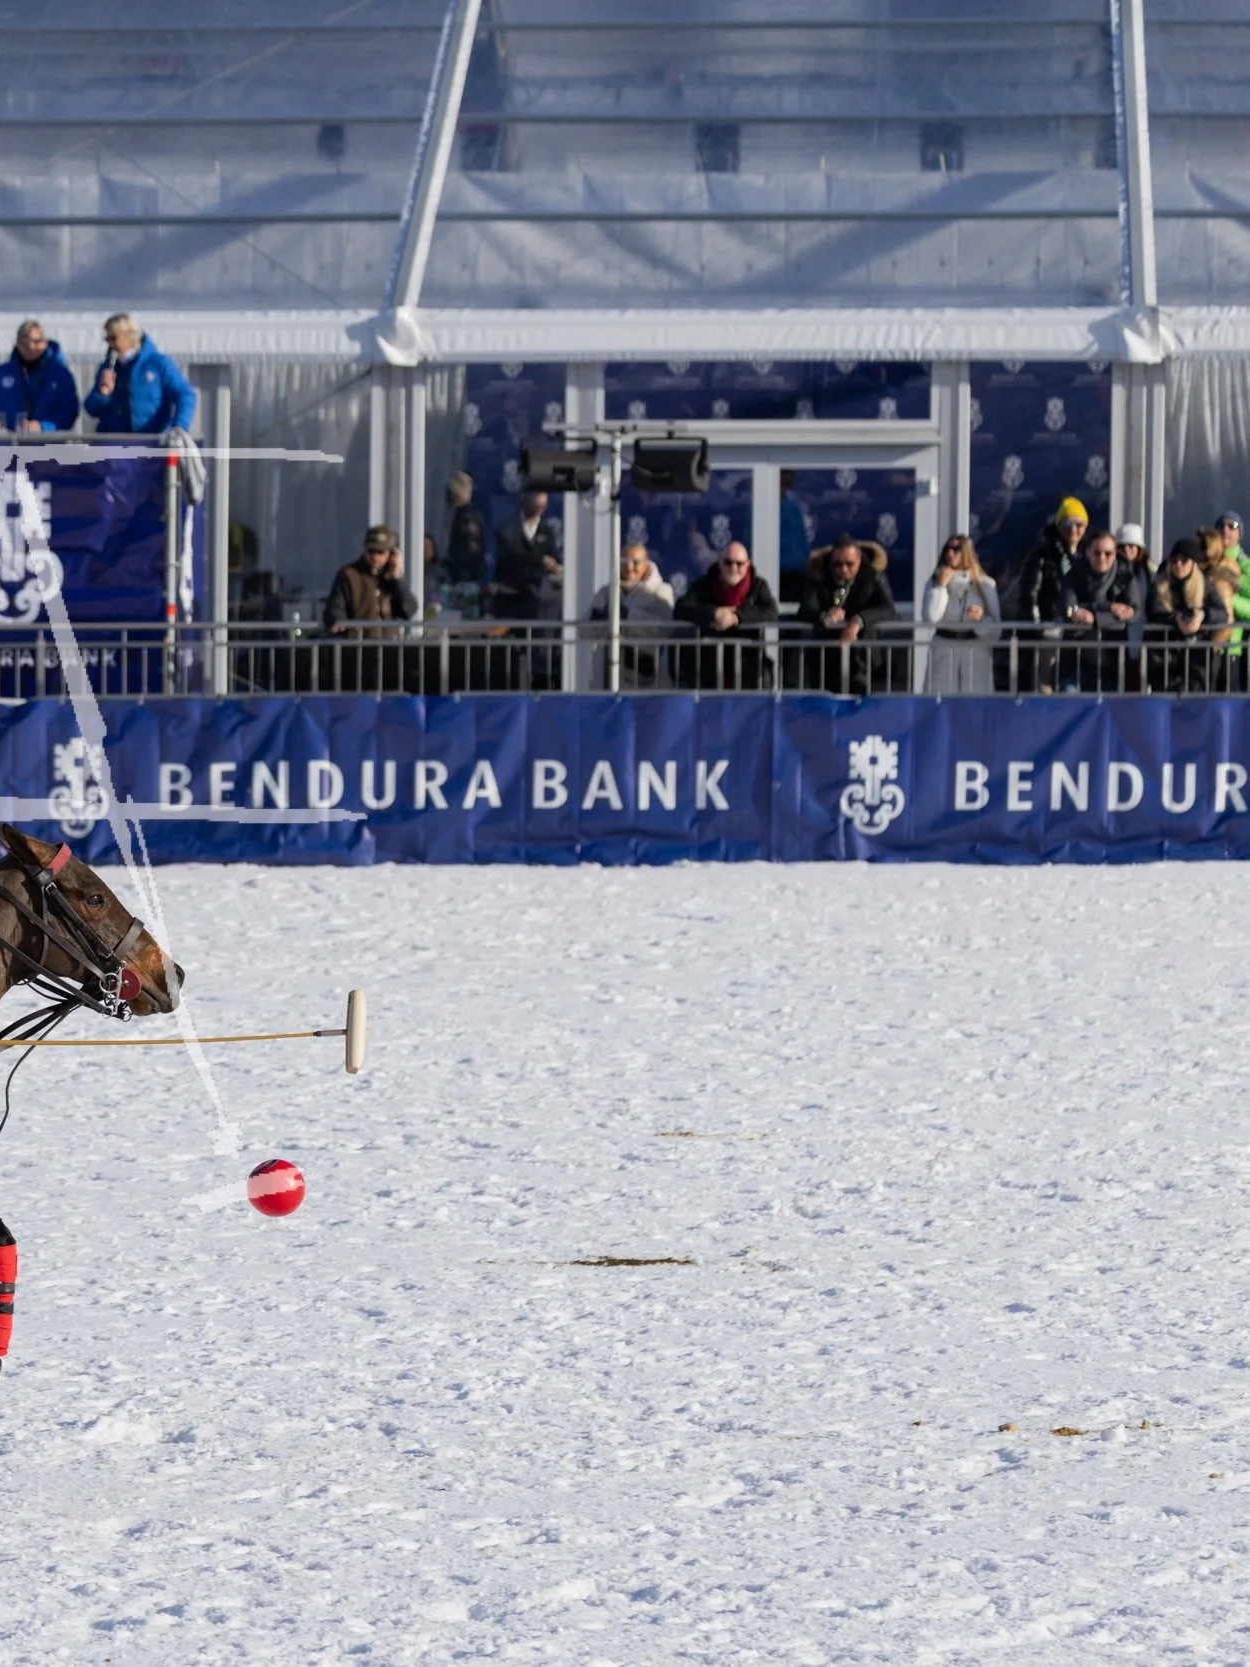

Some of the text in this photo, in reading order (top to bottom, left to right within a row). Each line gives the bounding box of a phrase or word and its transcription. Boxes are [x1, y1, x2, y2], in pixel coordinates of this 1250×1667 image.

[158, 759, 731, 812] BENDURA BANK
[954, 760, 1249, 814] BENDUR
